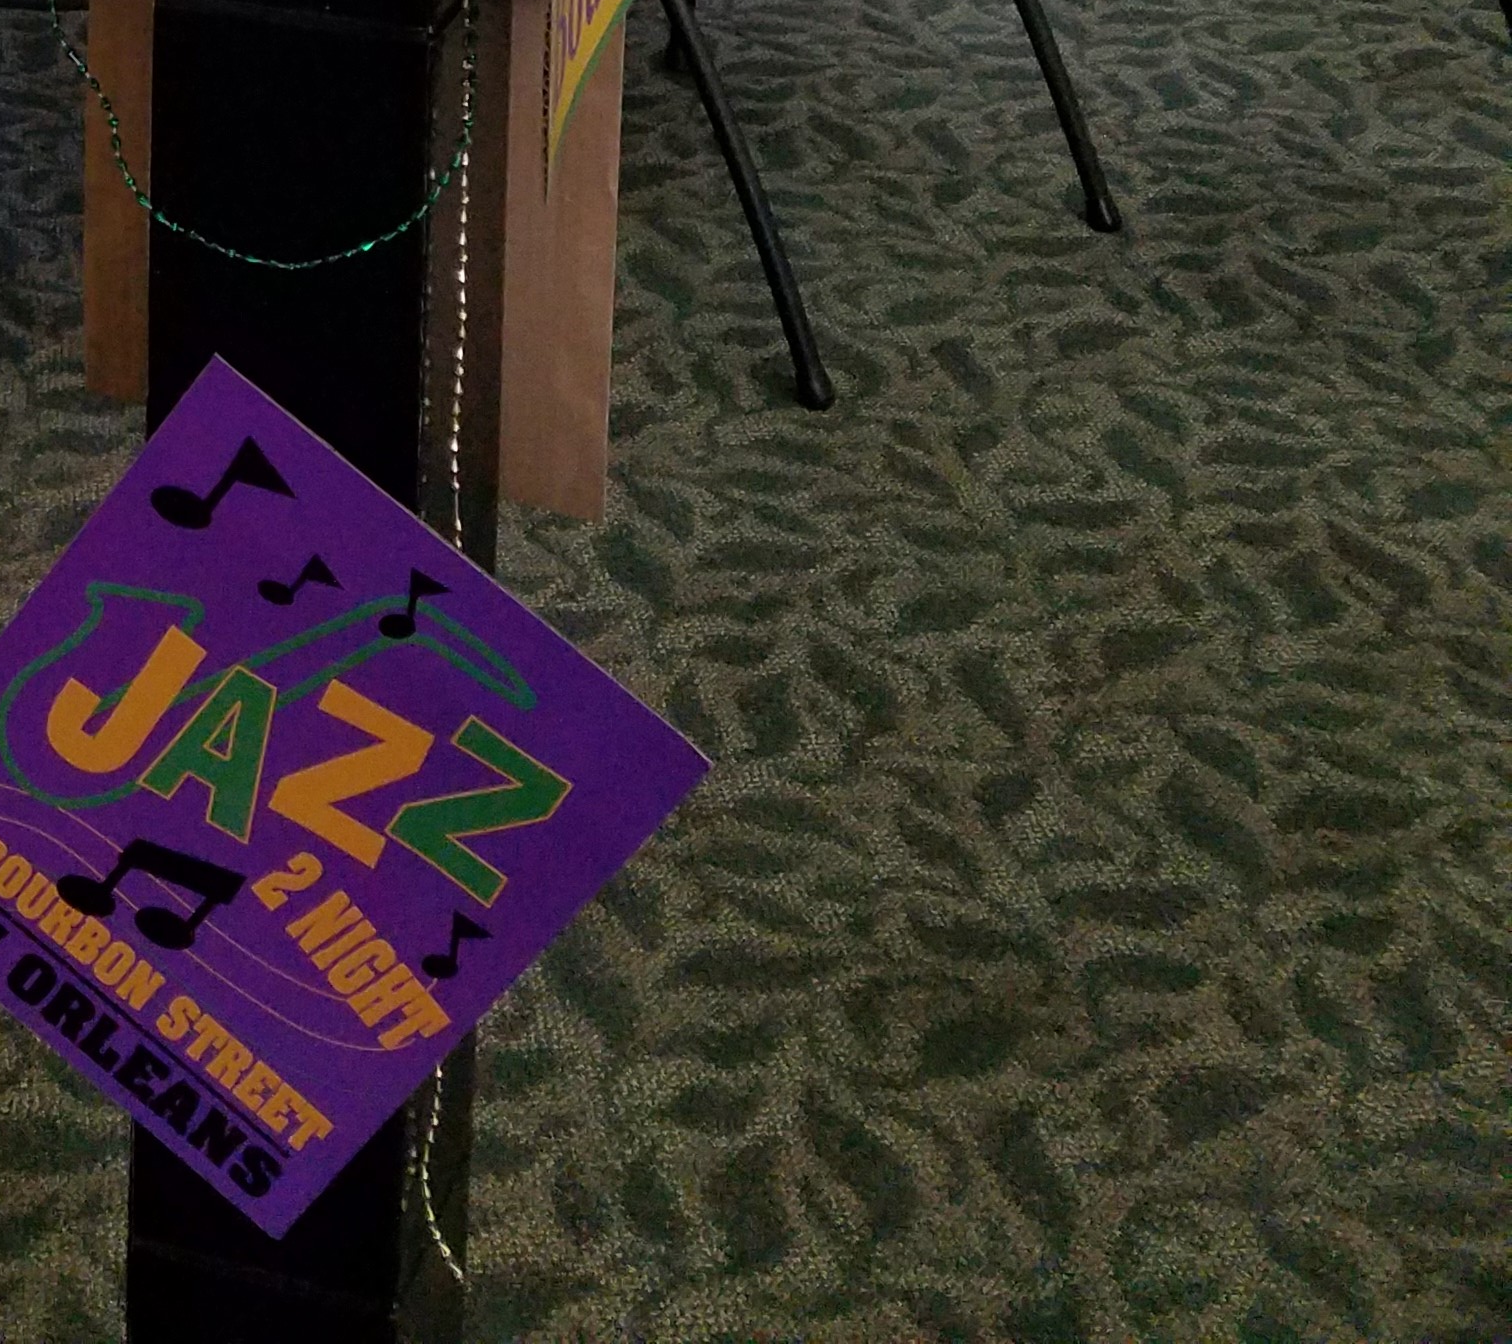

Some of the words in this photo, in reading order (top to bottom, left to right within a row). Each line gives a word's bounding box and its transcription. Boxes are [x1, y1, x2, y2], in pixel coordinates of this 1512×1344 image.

[45, 624, 573, 909] JAZZ
[250, 851, 325, 912] 2
[284, 889, 452, 1051] NIGHT
[6, 952, 284, 1198] ORLEANS
[155, 995, 335, 1152] STREET
